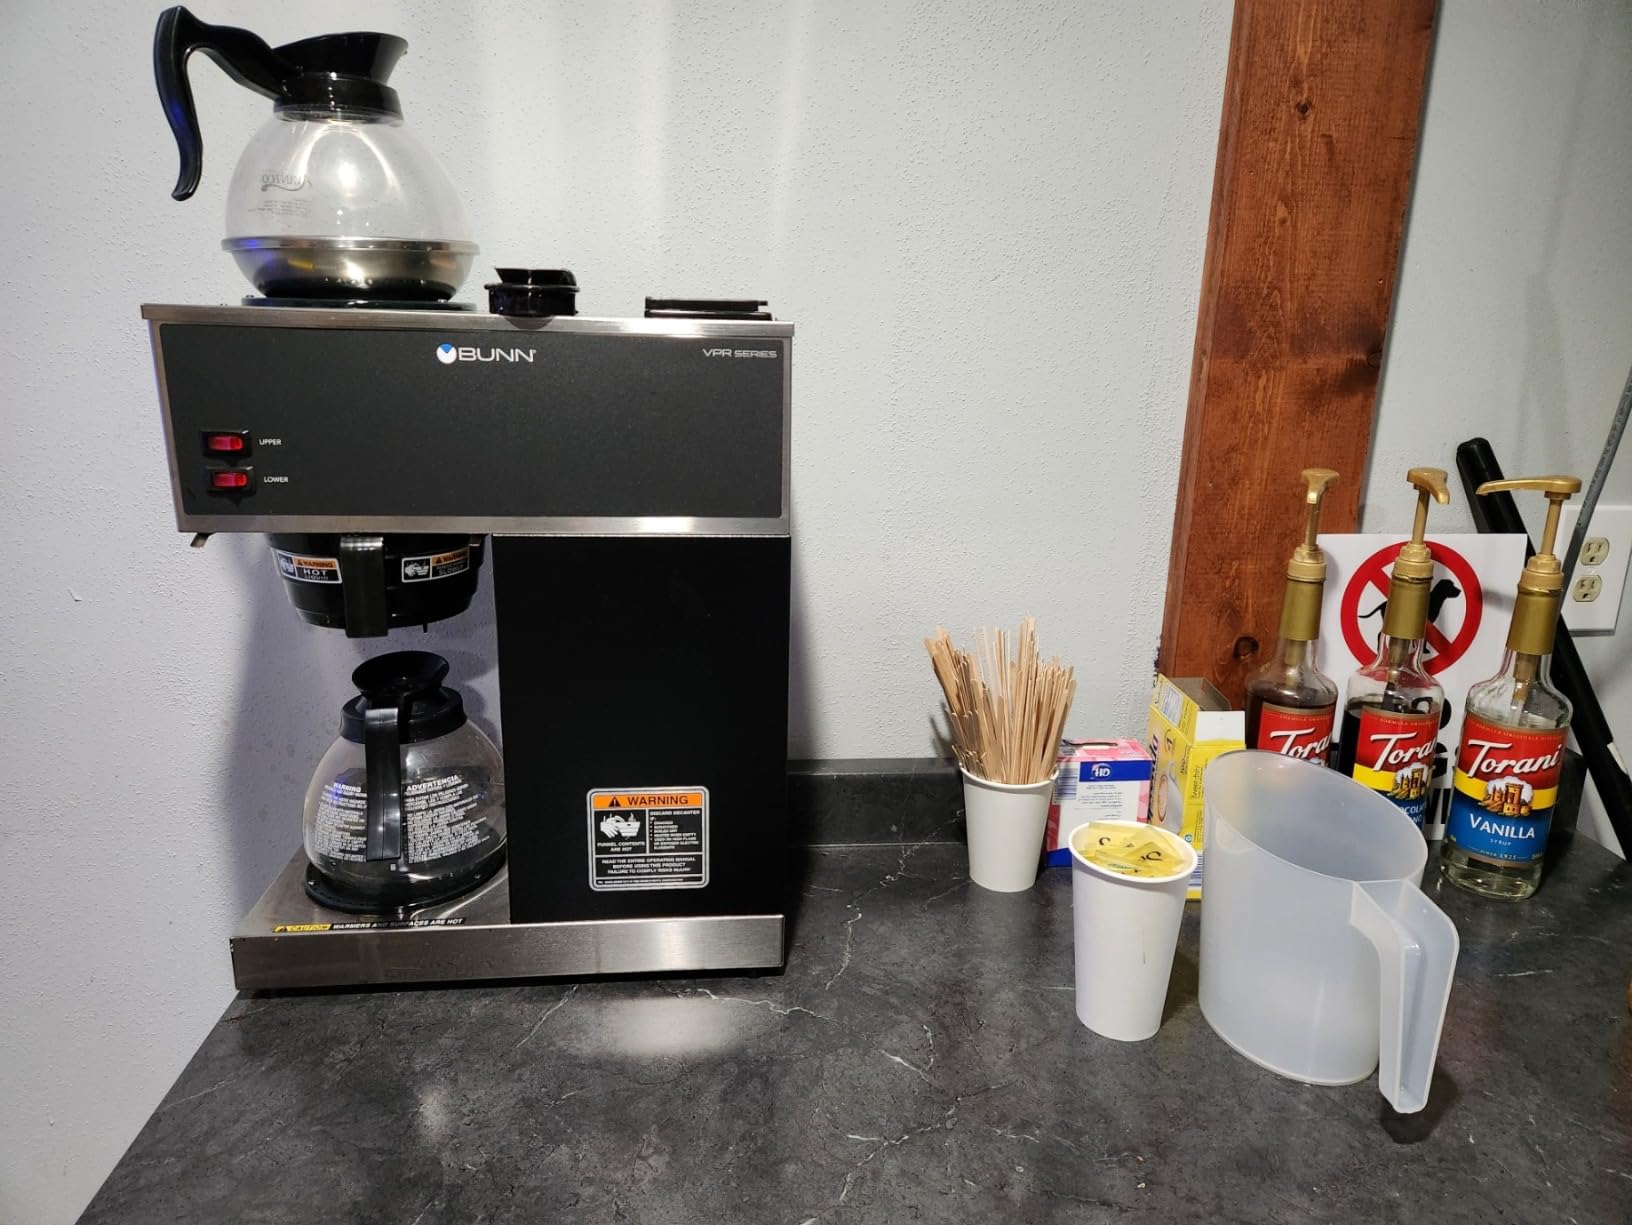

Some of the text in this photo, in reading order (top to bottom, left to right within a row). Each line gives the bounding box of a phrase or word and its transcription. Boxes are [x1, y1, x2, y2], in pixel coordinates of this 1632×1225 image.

[458, 347, 536, 363] BUNN
[702, 348, 777, 358] VPR SERIES
[259, 438, 282, 446] UPPER
[263, 475, 289, 483] LOWER
[303, 559, 333, 568] WARNING
[303, 568, 327, 576] HOT
[1269, 727, 1332, 758] Tora
[1370, 731, 1436, 771] Tora
[1468, 738, 1562, 778] Torani
[406, 774, 459, 791] ADVERTENCIA
[627, 795, 688, 806] WARNING
[1470, 813, 1535, 839] VANILLA
[1490, 838, 1512, 846] SYRUP
[390, 919, 429, 927] SURFACES
